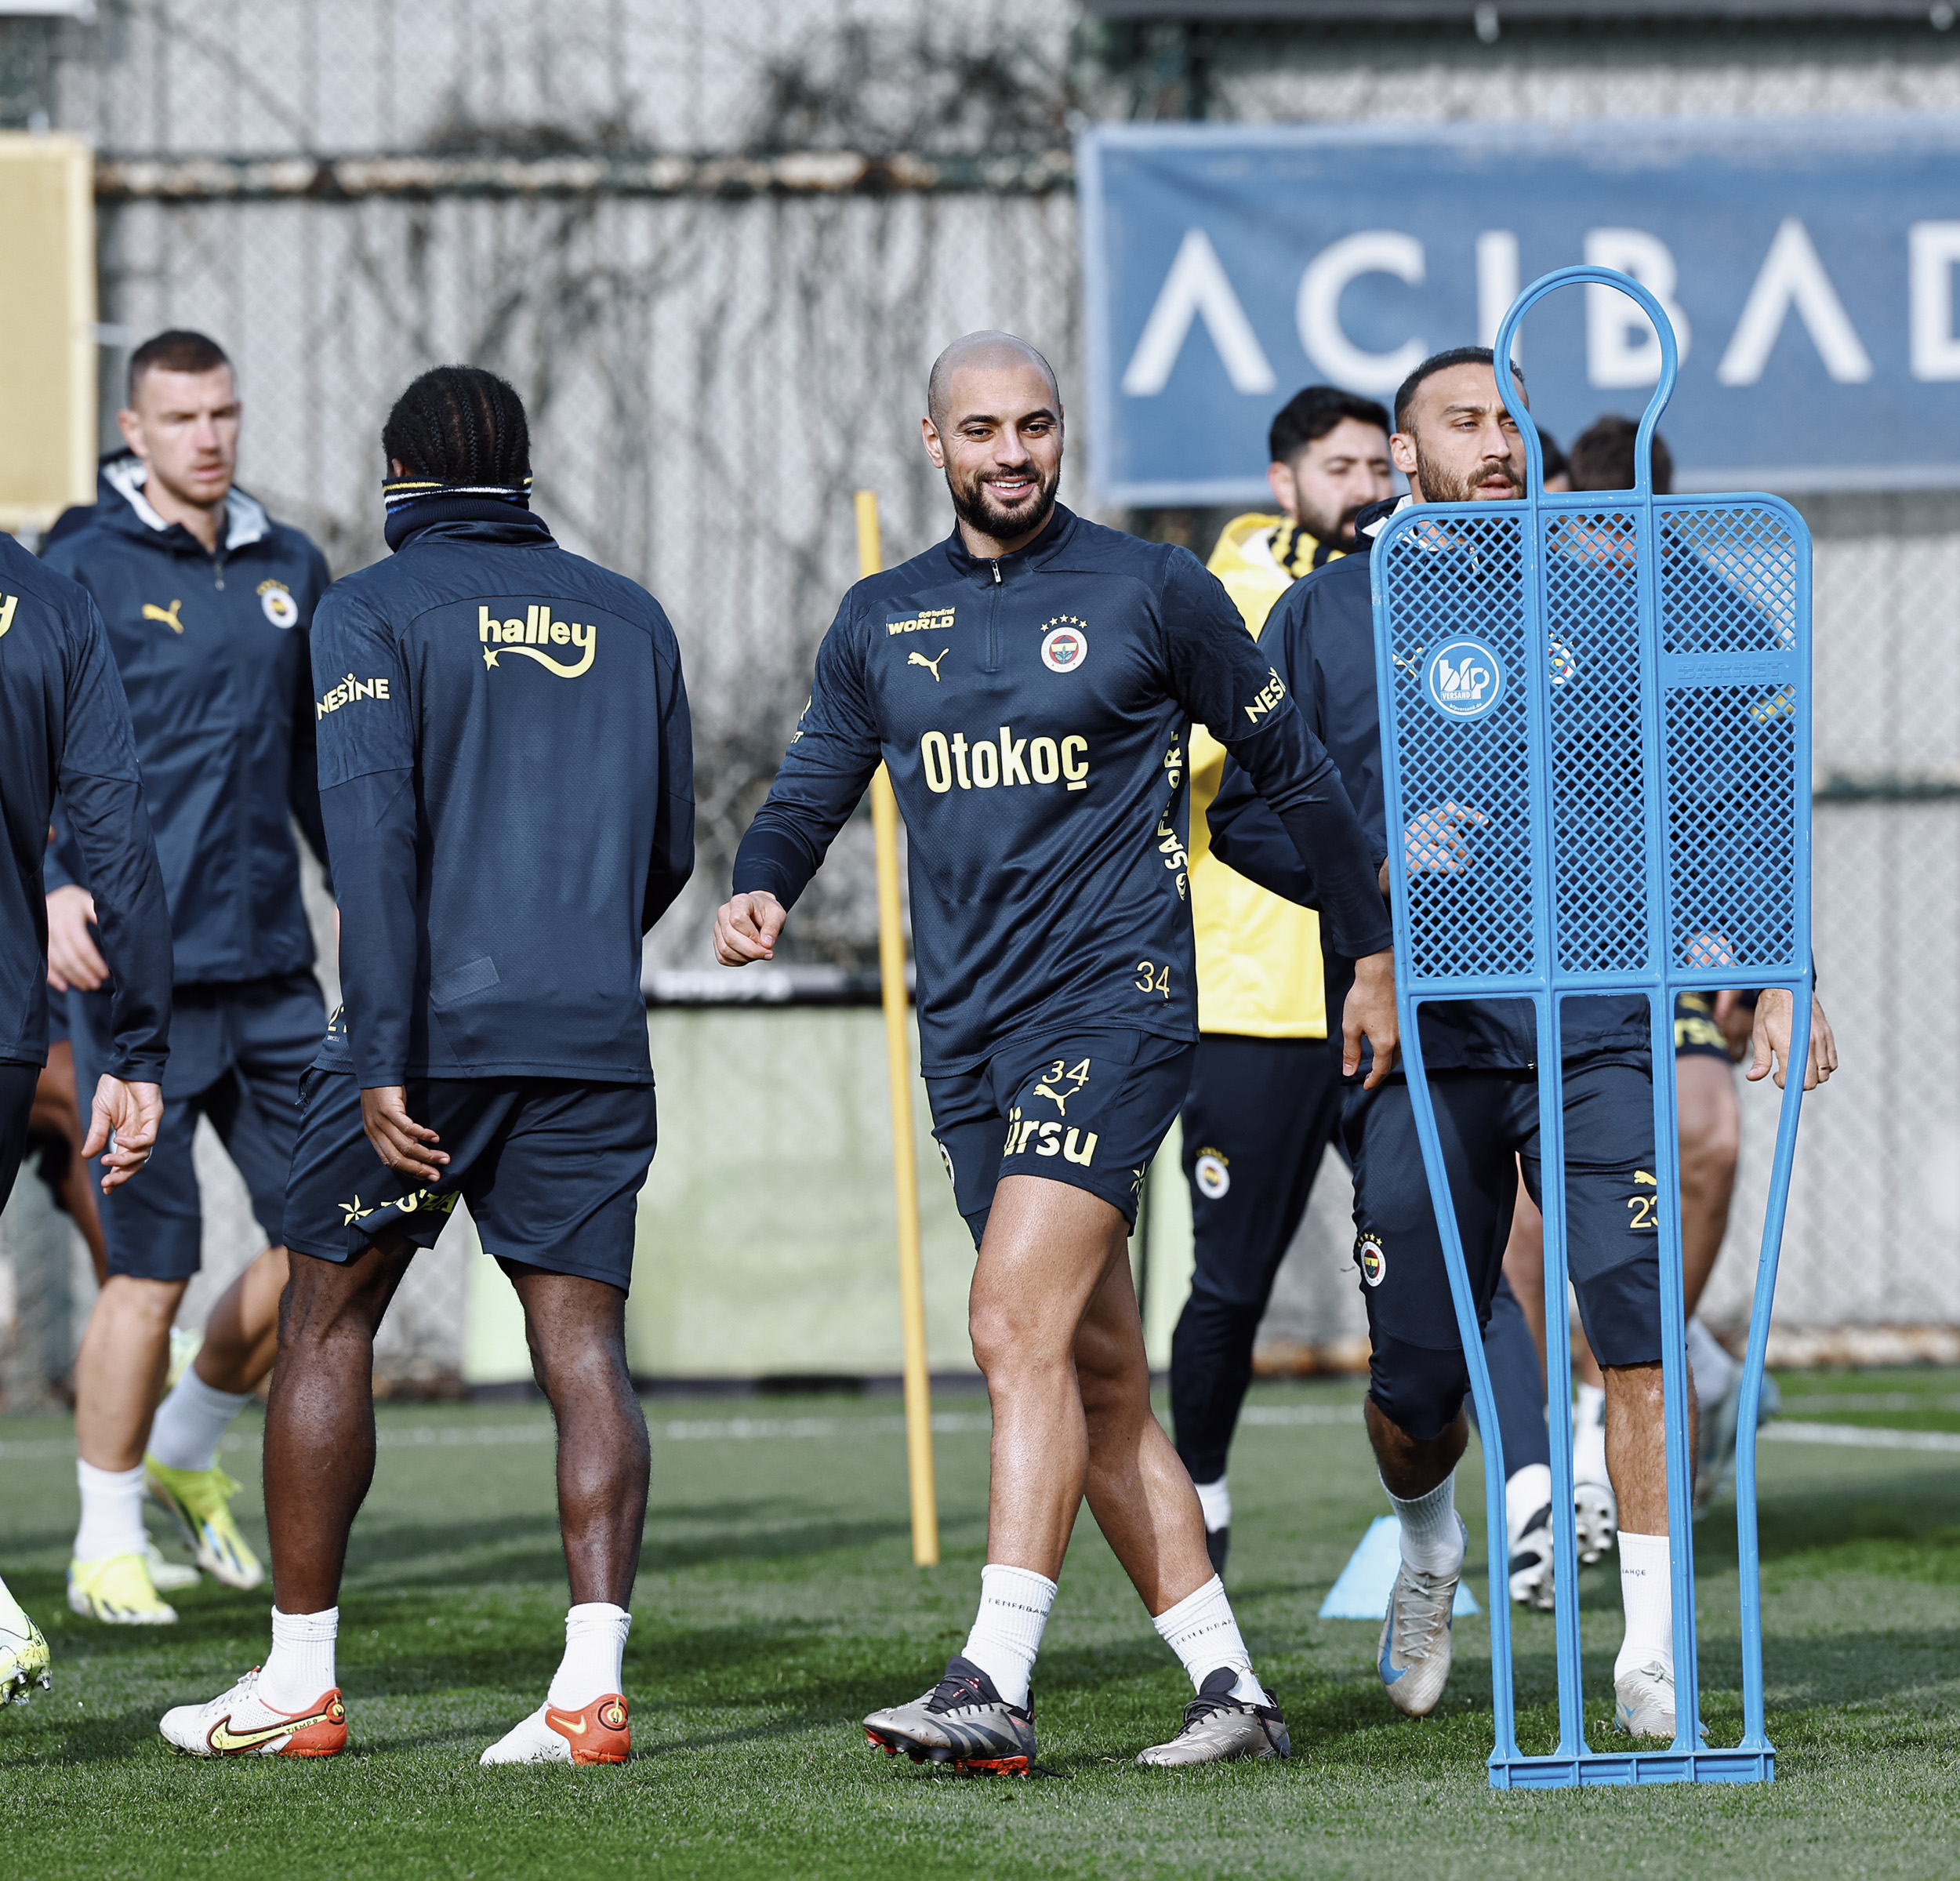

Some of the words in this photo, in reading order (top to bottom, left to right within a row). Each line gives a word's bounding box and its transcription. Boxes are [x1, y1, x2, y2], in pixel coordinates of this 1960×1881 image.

[887, 616, 955, 636] WORLD
[478, 605, 597, 679] halley
[1441, 692, 1472, 700] VERSAND
[920, 726, 1089, 793] Otokoç
[1135, 961, 1171, 1000] 34
[327, 1006, 347, 1033] 2
[1042, 1059, 1091, 1087] 34
[285, 1718, 318, 1734] TIEMPO
